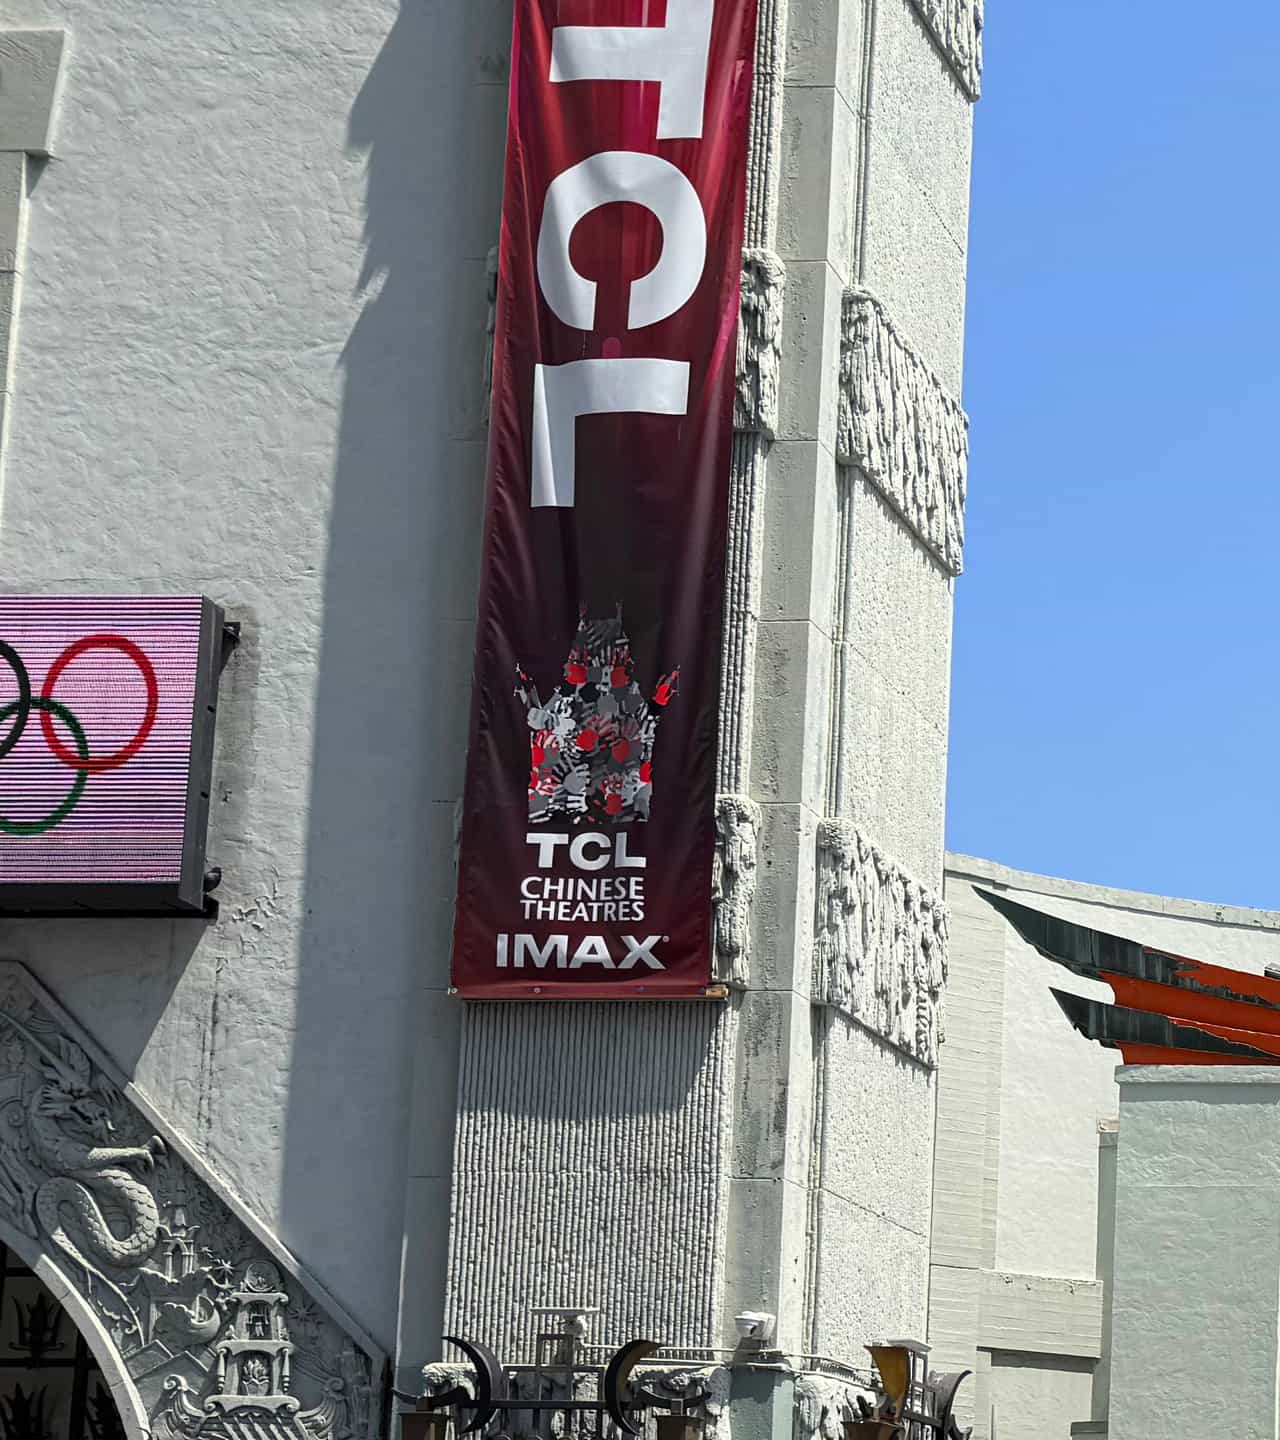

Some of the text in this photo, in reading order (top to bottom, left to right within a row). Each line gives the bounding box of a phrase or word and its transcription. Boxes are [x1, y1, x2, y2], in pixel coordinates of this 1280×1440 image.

[530, 0, 714, 508] TCL
[525, 831, 647, 871] TCL
[519, 876, 645, 901] CHINESE
[519, 900, 645, 922] THEATRES
[495, 932, 669, 970] IMAX
